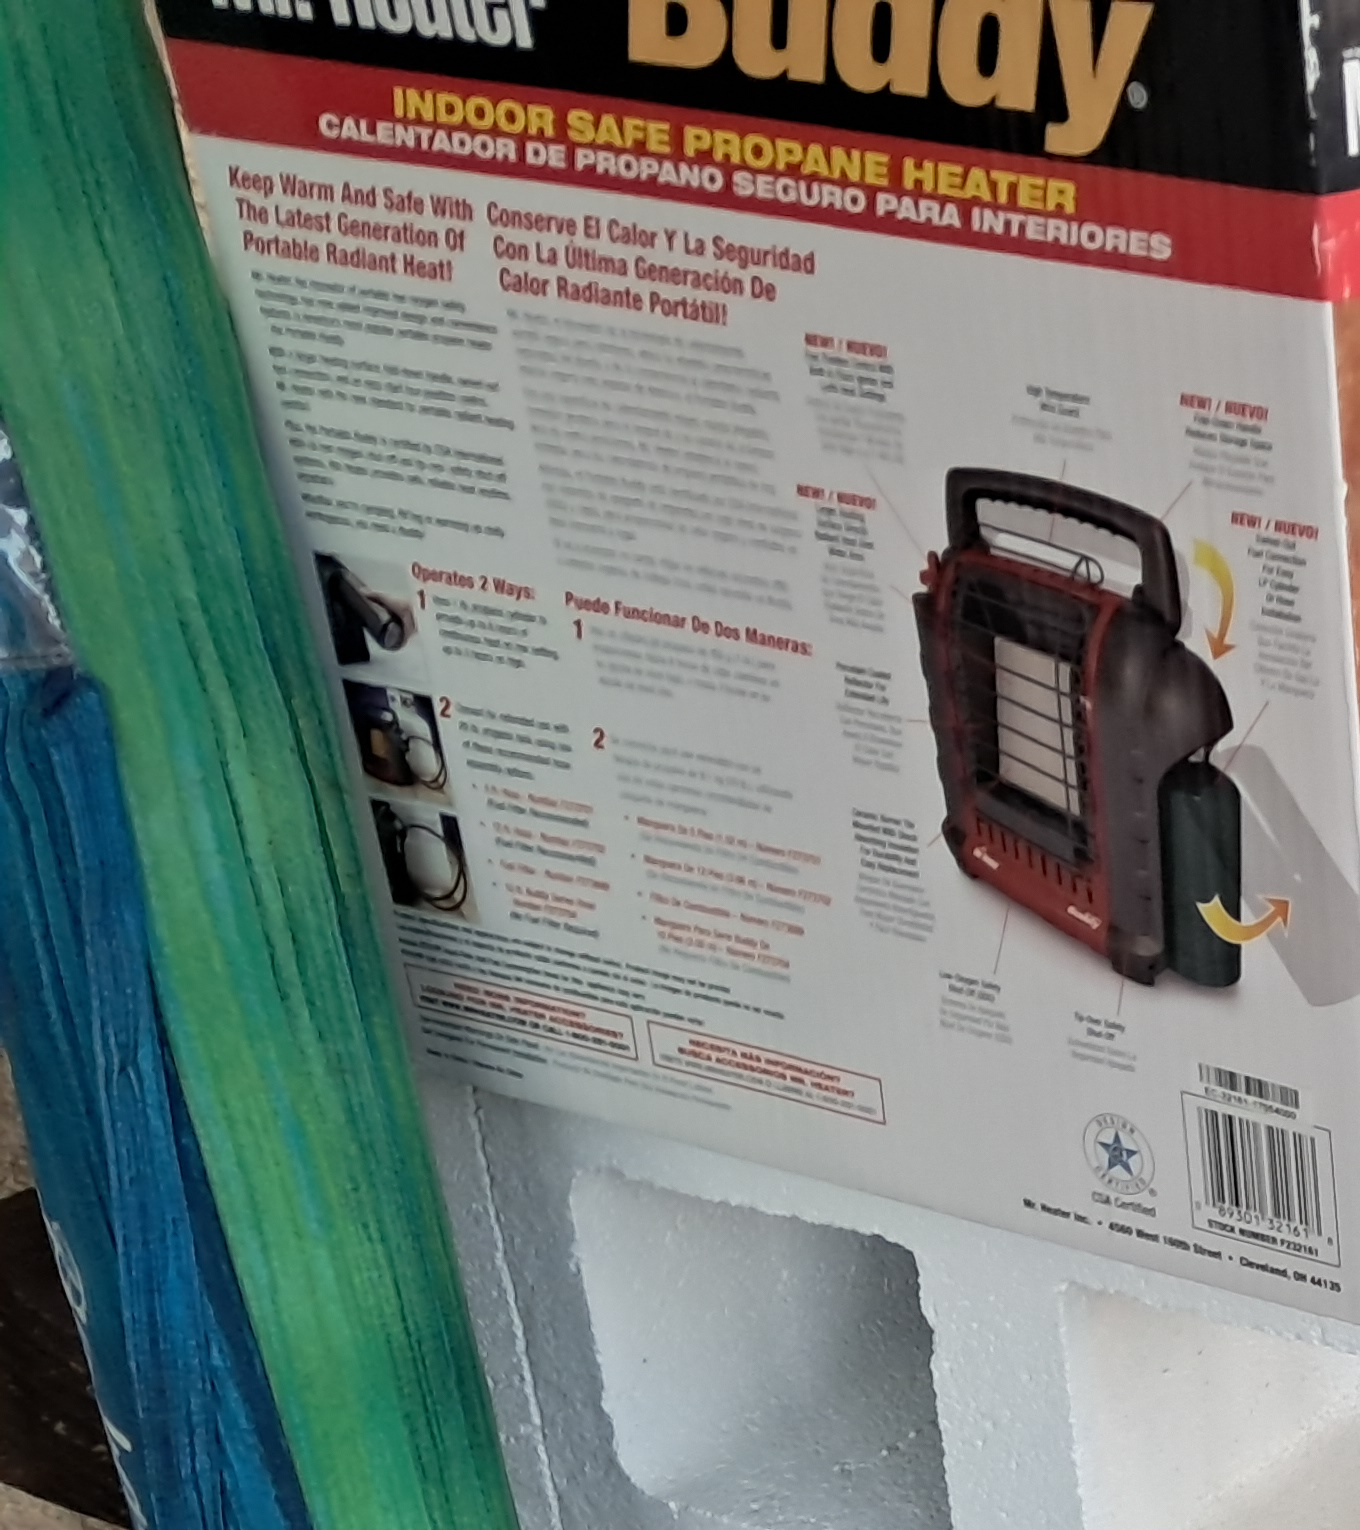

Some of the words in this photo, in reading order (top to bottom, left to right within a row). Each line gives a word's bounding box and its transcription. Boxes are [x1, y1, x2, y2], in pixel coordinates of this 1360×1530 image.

[393, 86, 554, 138] INDOOR
[567, 110, 671, 155] SAFE
[684, 126, 888, 187] PROPANE
[903, 155, 1077, 213] HEATER
[228, 165, 274, 198] Keep
[279, 172, 335, 202] Warm
[341, 181, 377, 208] And
[382, 186, 425, 216] Safe
[430, 194, 474, 222] With
[318, 113, 517, 163] CALENTADOR
[526, 139, 567, 171] DE
[575, 147, 724, 193] PROPANO
[733, 171, 867, 214] SEGURO
[877, 196, 962, 229] PARA
[972, 209, 1172, 260] INTERIORES
[235, 197, 269, 224] The
[274, 205, 331, 233] Latest
[337, 212, 439, 248] Generation
[444, 227, 466, 252] Of
[486, 201, 577, 236] Conserve
[583, 215, 601, 238] El
[607, 218, 658, 249] Calor
[664, 229, 677, 251] Y
[684, 232, 706, 257] La
[712, 235, 815, 275] Seguridad
[242, 230, 320, 263] Portable
[326, 242, 397, 274] Radiant
[403, 253, 453, 281] Heat!
[493, 235, 529, 261] Con
[536, 241, 557, 266] La
[565, 241, 628, 277] Última
[634, 255, 744, 295] Generación
[751, 276, 777, 301] De
[499, 267, 549, 296] Calor
[556, 277, 643, 311] Radiante
[1180, 392, 1212, 411] NEW!
[1216, 400, 1221, 412] /
[1225, 400, 1269, 421] NUEVO!
[1231, 511, 1262, 529] NEW!
[1274, 521, 1319, 540] NUEVO!
[411, 561, 475, 591] Operates
[480, 574, 490, 591] 2
[493, 578, 535, 600] Ways:
[417, 590, 427, 609] 1
[564, 592, 610, 617] Puede
[613, 601, 687, 630] Funcionar
[691, 614, 710, 634] De
[714, 619, 741, 641] Dos
[744, 627, 813, 656] Maneras:
[573, 619, 583, 639] 1
[439, 698, 451, 718] 2
[592, 728, 606, 750] 2
[1268, 1218, 1309, 1238] 32161
[1239, 1256, 1291, 1280] Cleveland,
